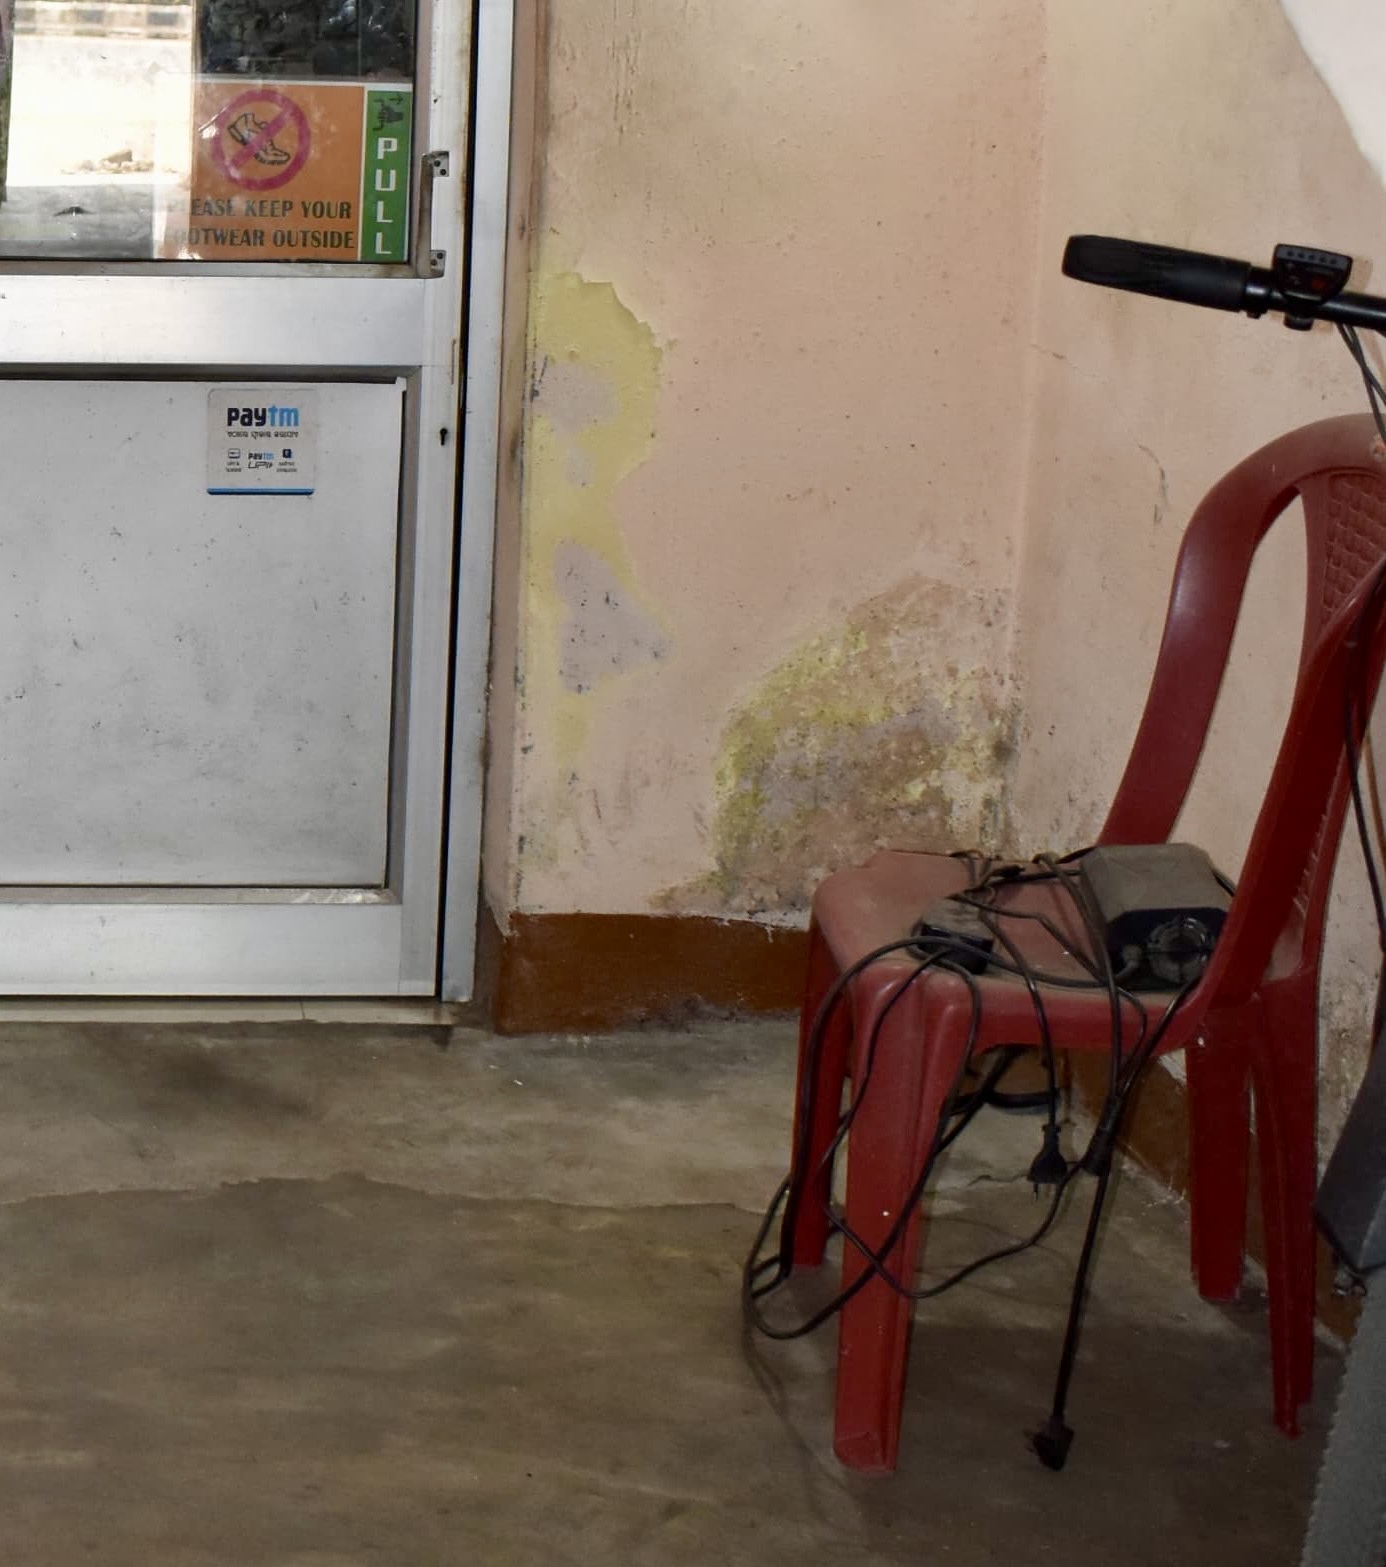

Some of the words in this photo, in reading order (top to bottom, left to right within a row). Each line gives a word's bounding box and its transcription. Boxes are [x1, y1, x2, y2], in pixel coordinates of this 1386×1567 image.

[374, 136, 398, 255] PULL
[168, 197, 237, 217] EASE
[244, 199, 295, 218] KEEP
[300, 201, 352, 220] YOUR
[272, 229, 355, 249] OUTSIDE
